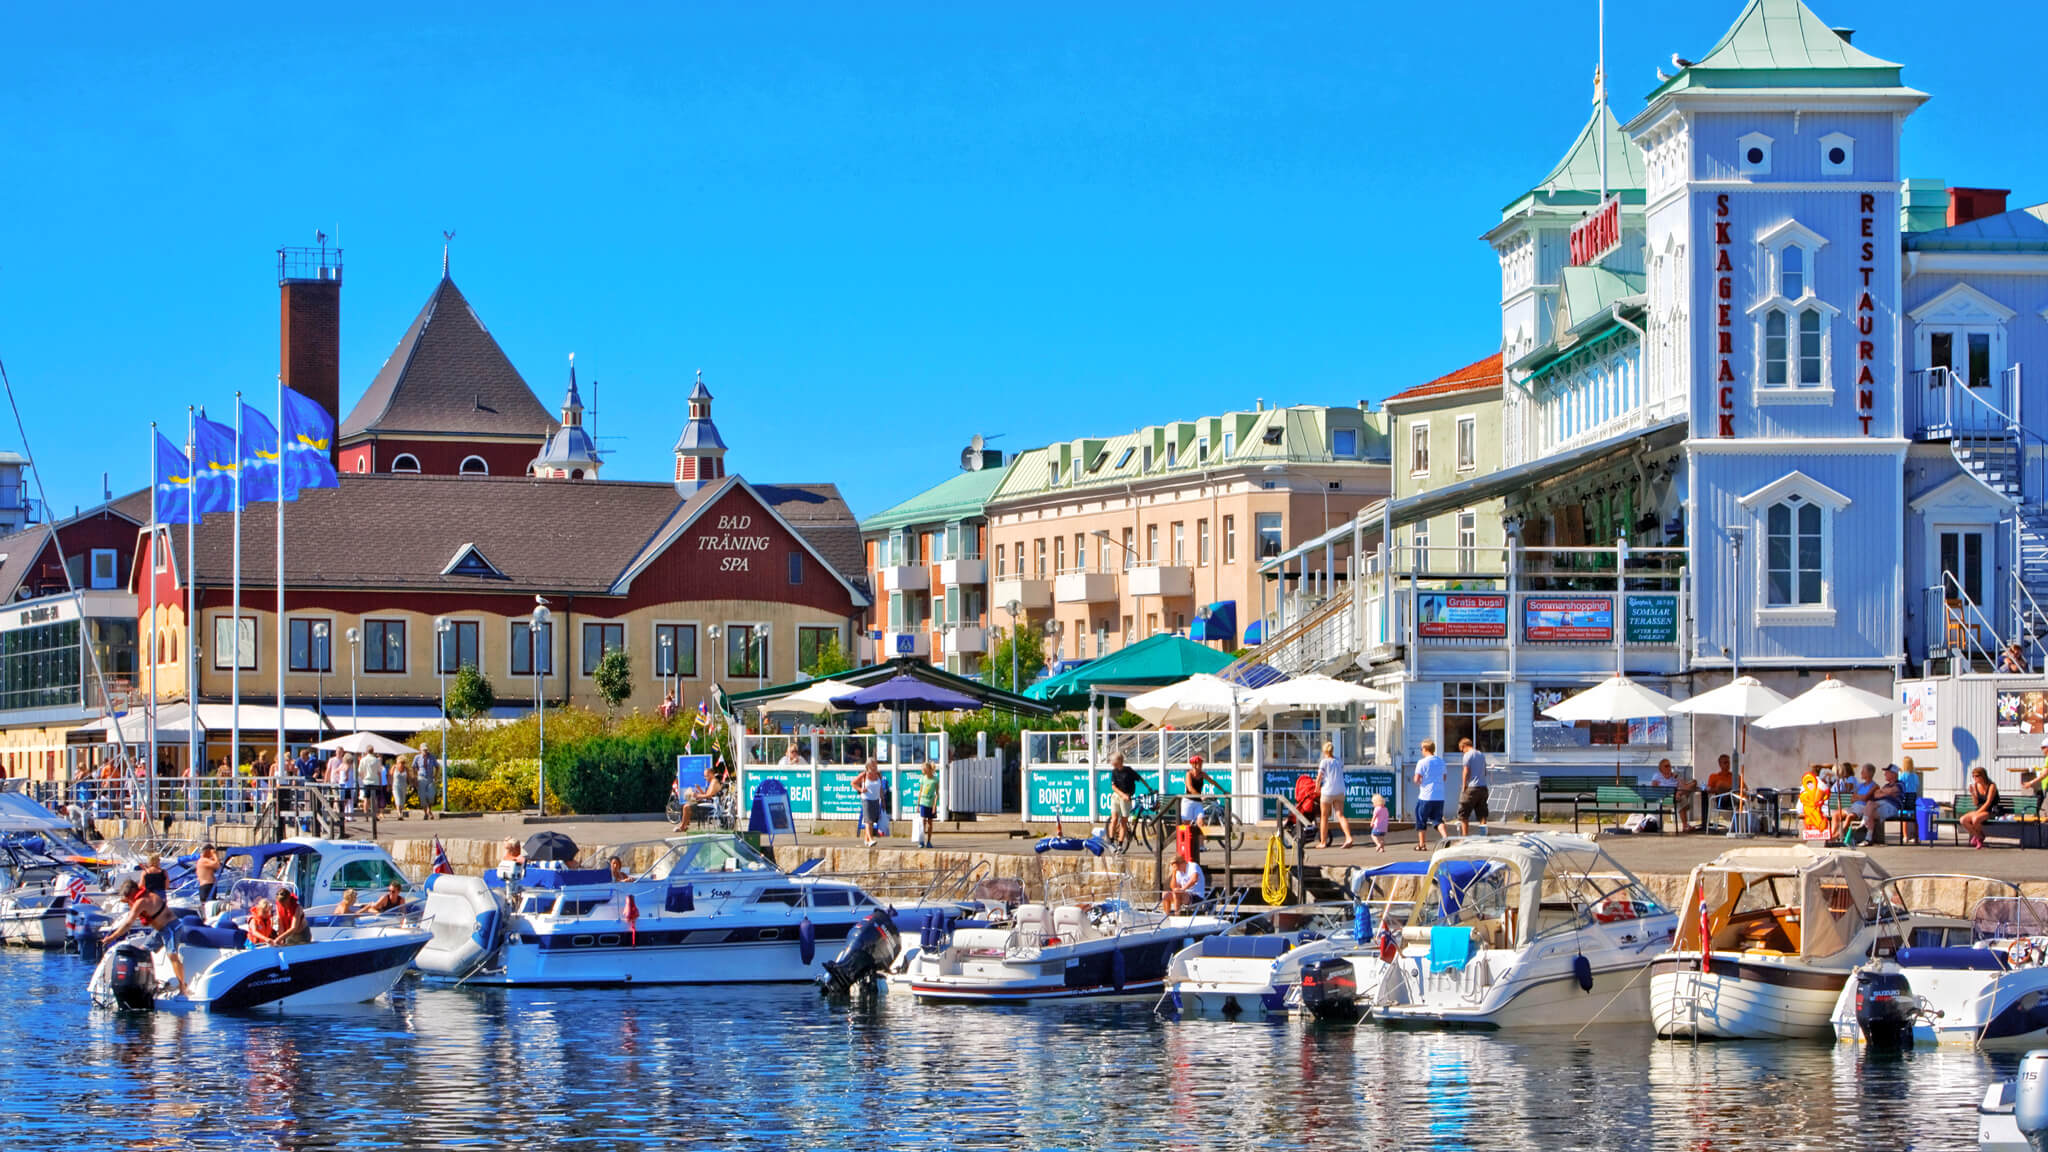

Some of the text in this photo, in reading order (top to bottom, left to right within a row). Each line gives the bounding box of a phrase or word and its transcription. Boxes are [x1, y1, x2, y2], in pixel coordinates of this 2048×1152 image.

[1715, 194, 1735, 437] SKAGERACK
[1858, 194, 1875, 435] RESTAURANT
[717, 515, 751, 530] BAD
[698, 533, 770, 551] TRÄNING
[720, 557, 749, 571] SPA
[1449, 598, 1503, 606] Gratis buss!
[1530, 601, 1608, 611] Sommarshopping!
[1632, 608, 1671, 616] SOMMAR
[1629, 617, 1672, 625] TERASSEN
[1039, 788, 1072, 804] BONEY
[1075, 788, 1085, 804] M
[2021, 1071, 2038, 1080] 115
